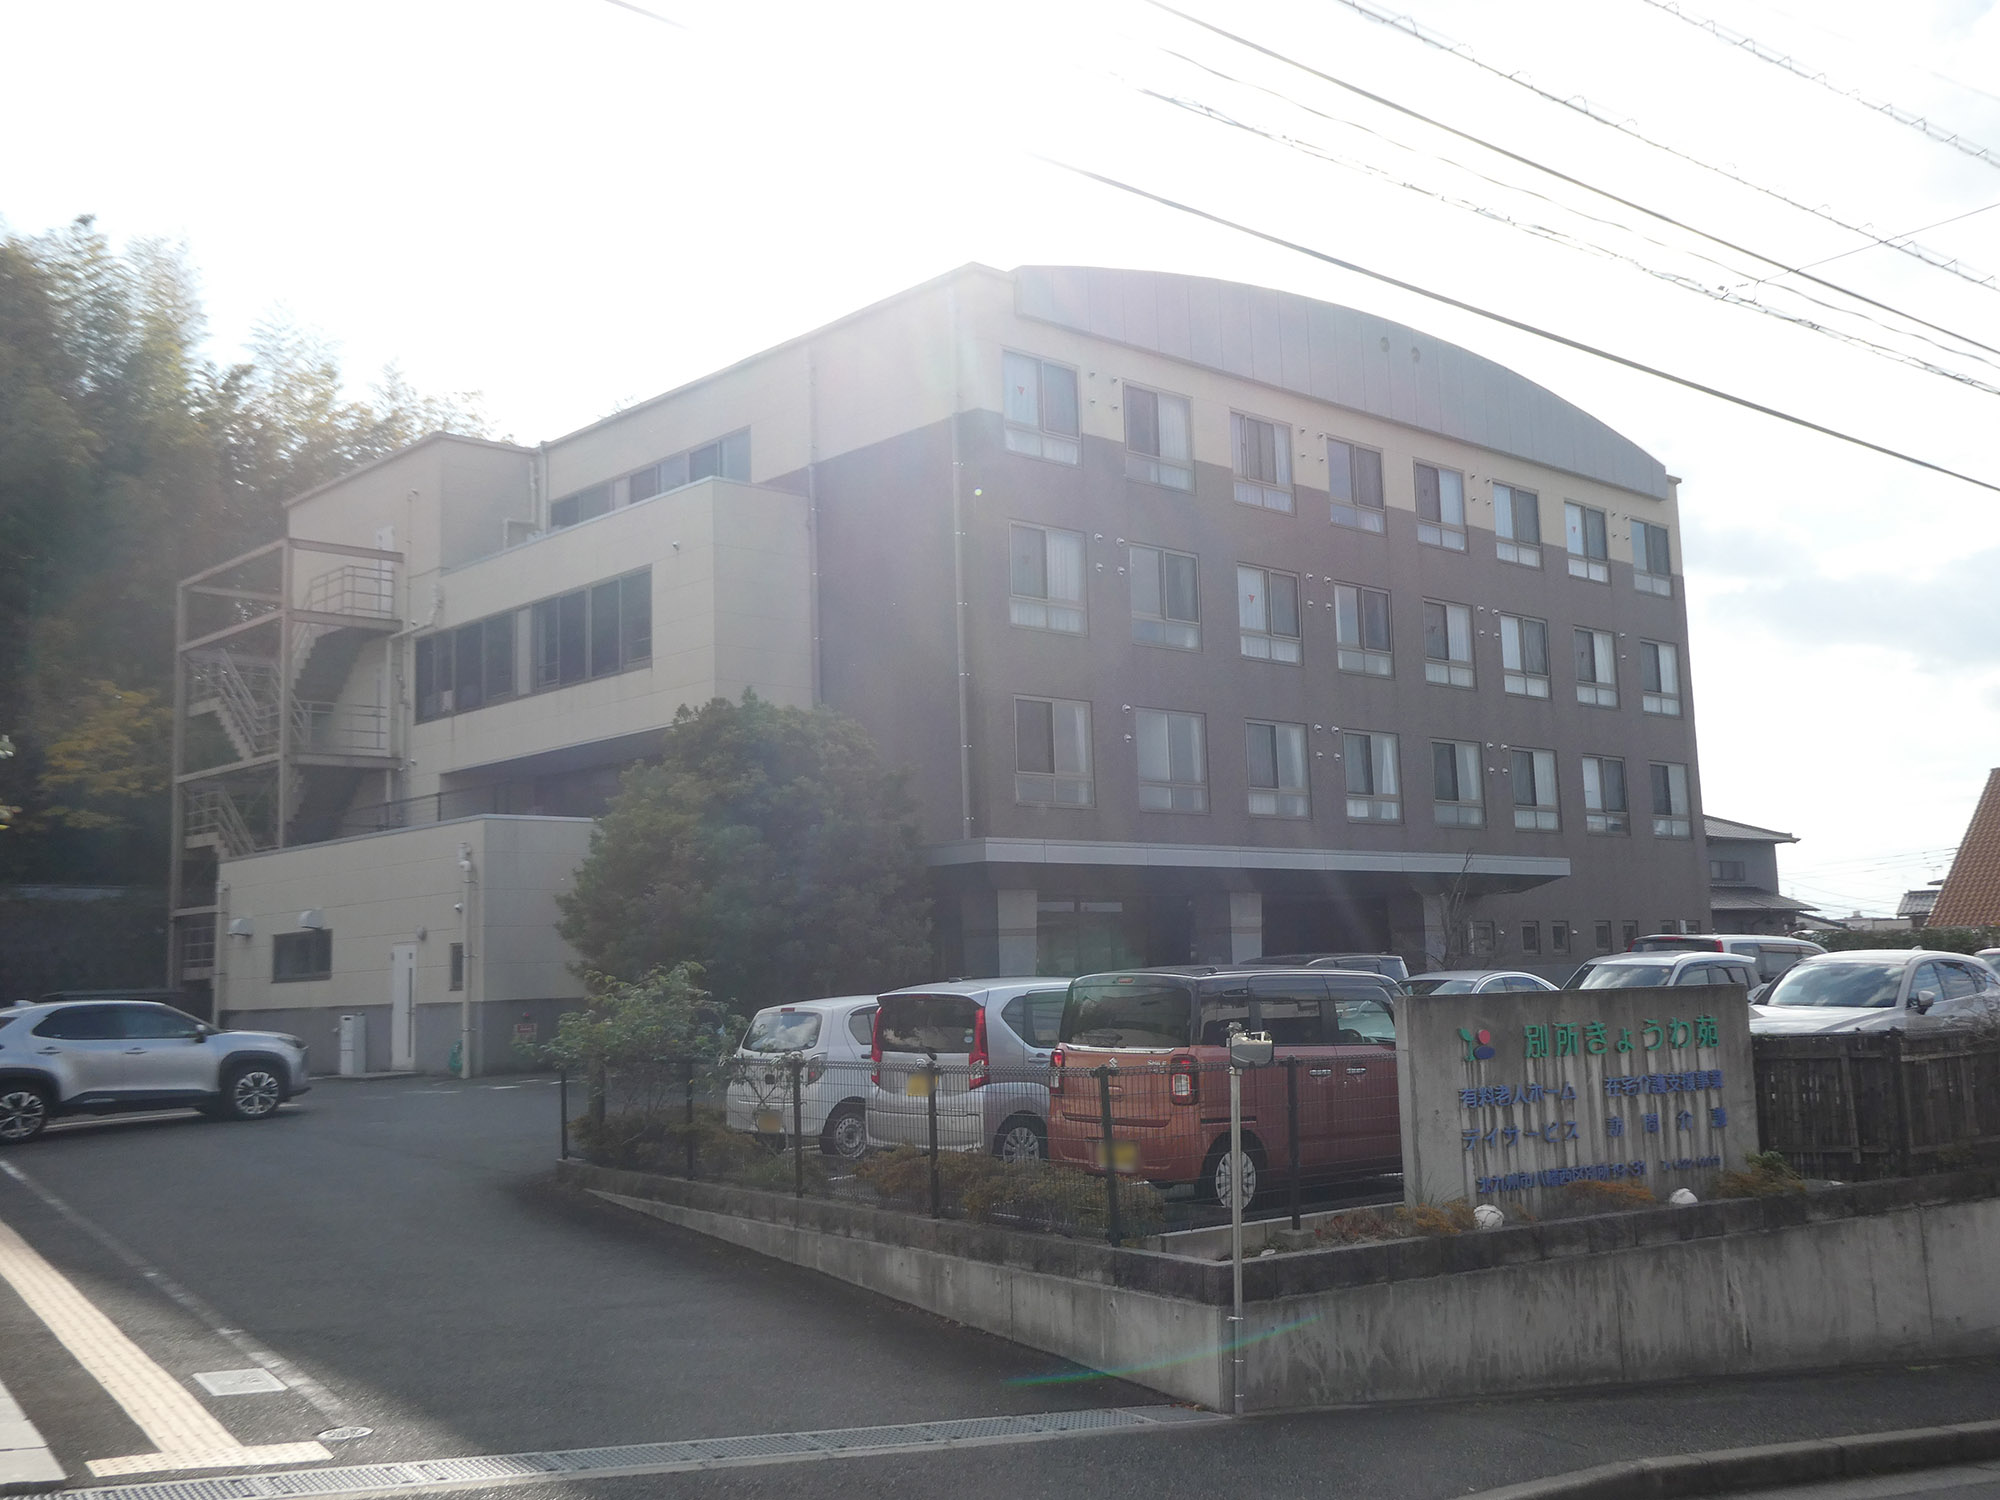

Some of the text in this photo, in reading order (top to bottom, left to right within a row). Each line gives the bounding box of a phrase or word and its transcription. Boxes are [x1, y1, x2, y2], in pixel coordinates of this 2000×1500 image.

[1525, 1015, 1720, 1058] 別所きょうわ苑
[1460, 1081, 1577, 1109] 有料老人ホーム
